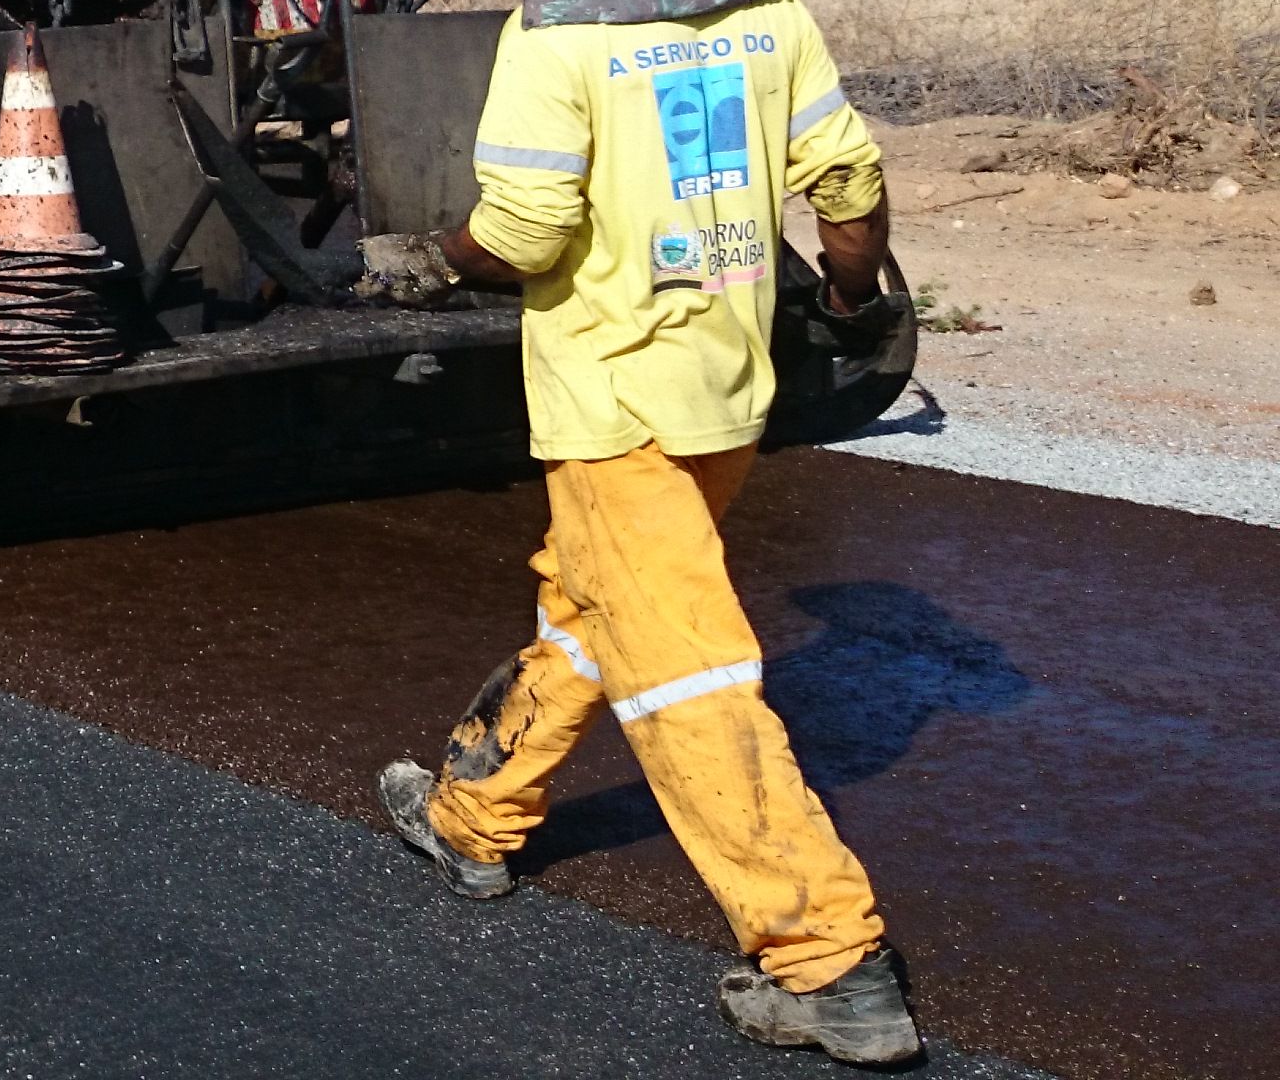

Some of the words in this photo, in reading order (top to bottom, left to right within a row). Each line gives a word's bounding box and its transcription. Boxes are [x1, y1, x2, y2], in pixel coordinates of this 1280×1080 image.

[608, 56, 628, 77] A
[634, 37, 732, 69] SERVIÇO
[742, 34, 776, 53] DO
